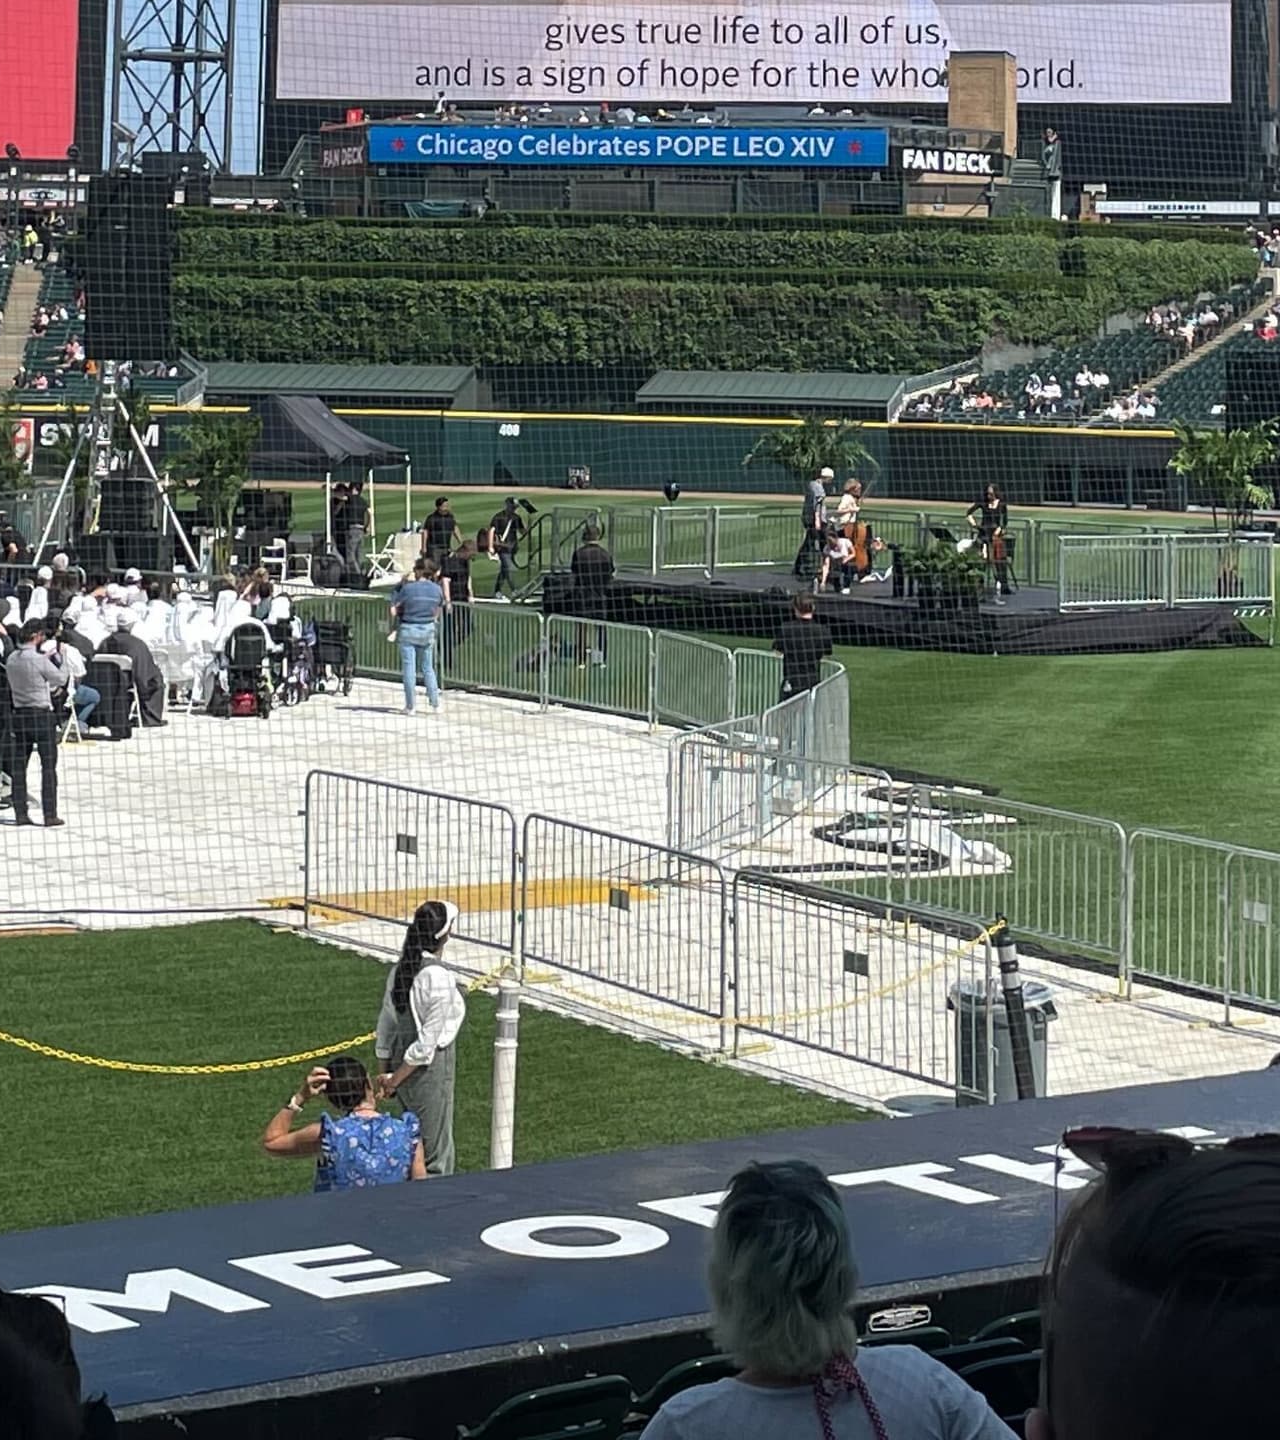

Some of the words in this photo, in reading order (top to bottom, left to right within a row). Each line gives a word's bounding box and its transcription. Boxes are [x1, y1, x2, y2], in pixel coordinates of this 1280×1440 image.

[545, 16, 625, 51] gives
[636, 18, 701, 44] true
[713, 16, 760, 44] life
[770, 21, 804, 45] to
[814, 16, 848, 44] all
[859, 16, 894, 44] of
[905, 24, 948, 49] us,
[415, 58, 471, 87] and
[483, 58, 505, 87] is
[516, 65, 533, 87] a
[542, 59, 605, 94] sign
[616, 58, 651, 87] of
[660, 58, 740, 94] hope
[750, 58, 792, 88] for
[807, 59, 860, 88] the
[871, 59, 948, 88] who
[1017, 59, 1084, 89] orld.
[323, 148, 340, 169] FAN
[341, 145, 364, 166] DECK
[416, 133, 513, 160] Chicago
[519, 133, 651, 158] Celebrates
[657, 135, 728, 158] POPE
[733, 135, 785, 158] LEO
[790, 136, 836, 159] XIV
[902, 148, 940, 171] FAN
[943, 150, 993, 173] DECK
